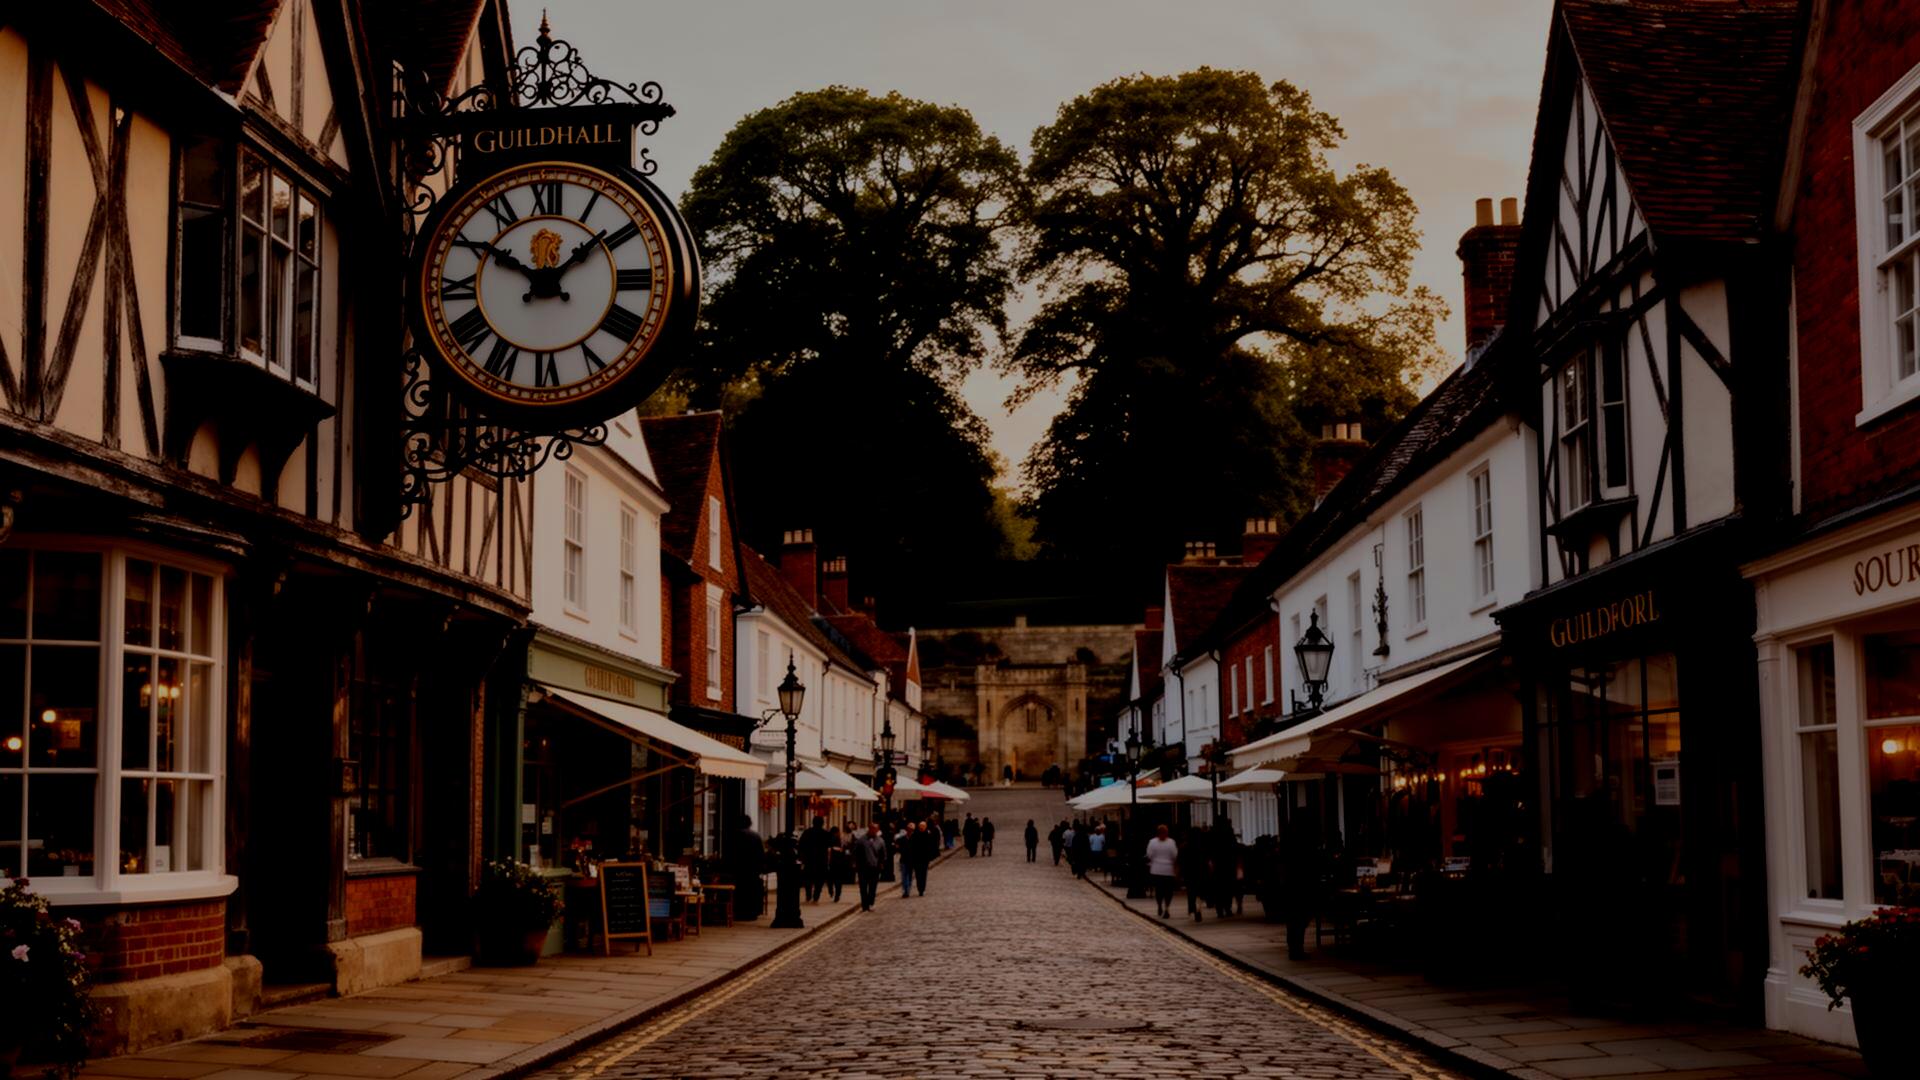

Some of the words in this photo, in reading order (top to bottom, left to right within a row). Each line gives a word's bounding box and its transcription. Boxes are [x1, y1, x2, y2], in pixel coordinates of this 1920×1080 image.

[473, 123, 622, 154] GUILDHALL
[530, 183, 563, 217] XII
[580, 191, 601, 224] I
[604, 219, 644, 251] II
[616, 268, 651, 292] III
[535, 351, 560, 387] VI
[580, 341, 608, 377] V
[1853, 543, 1920, 596] SOUR
